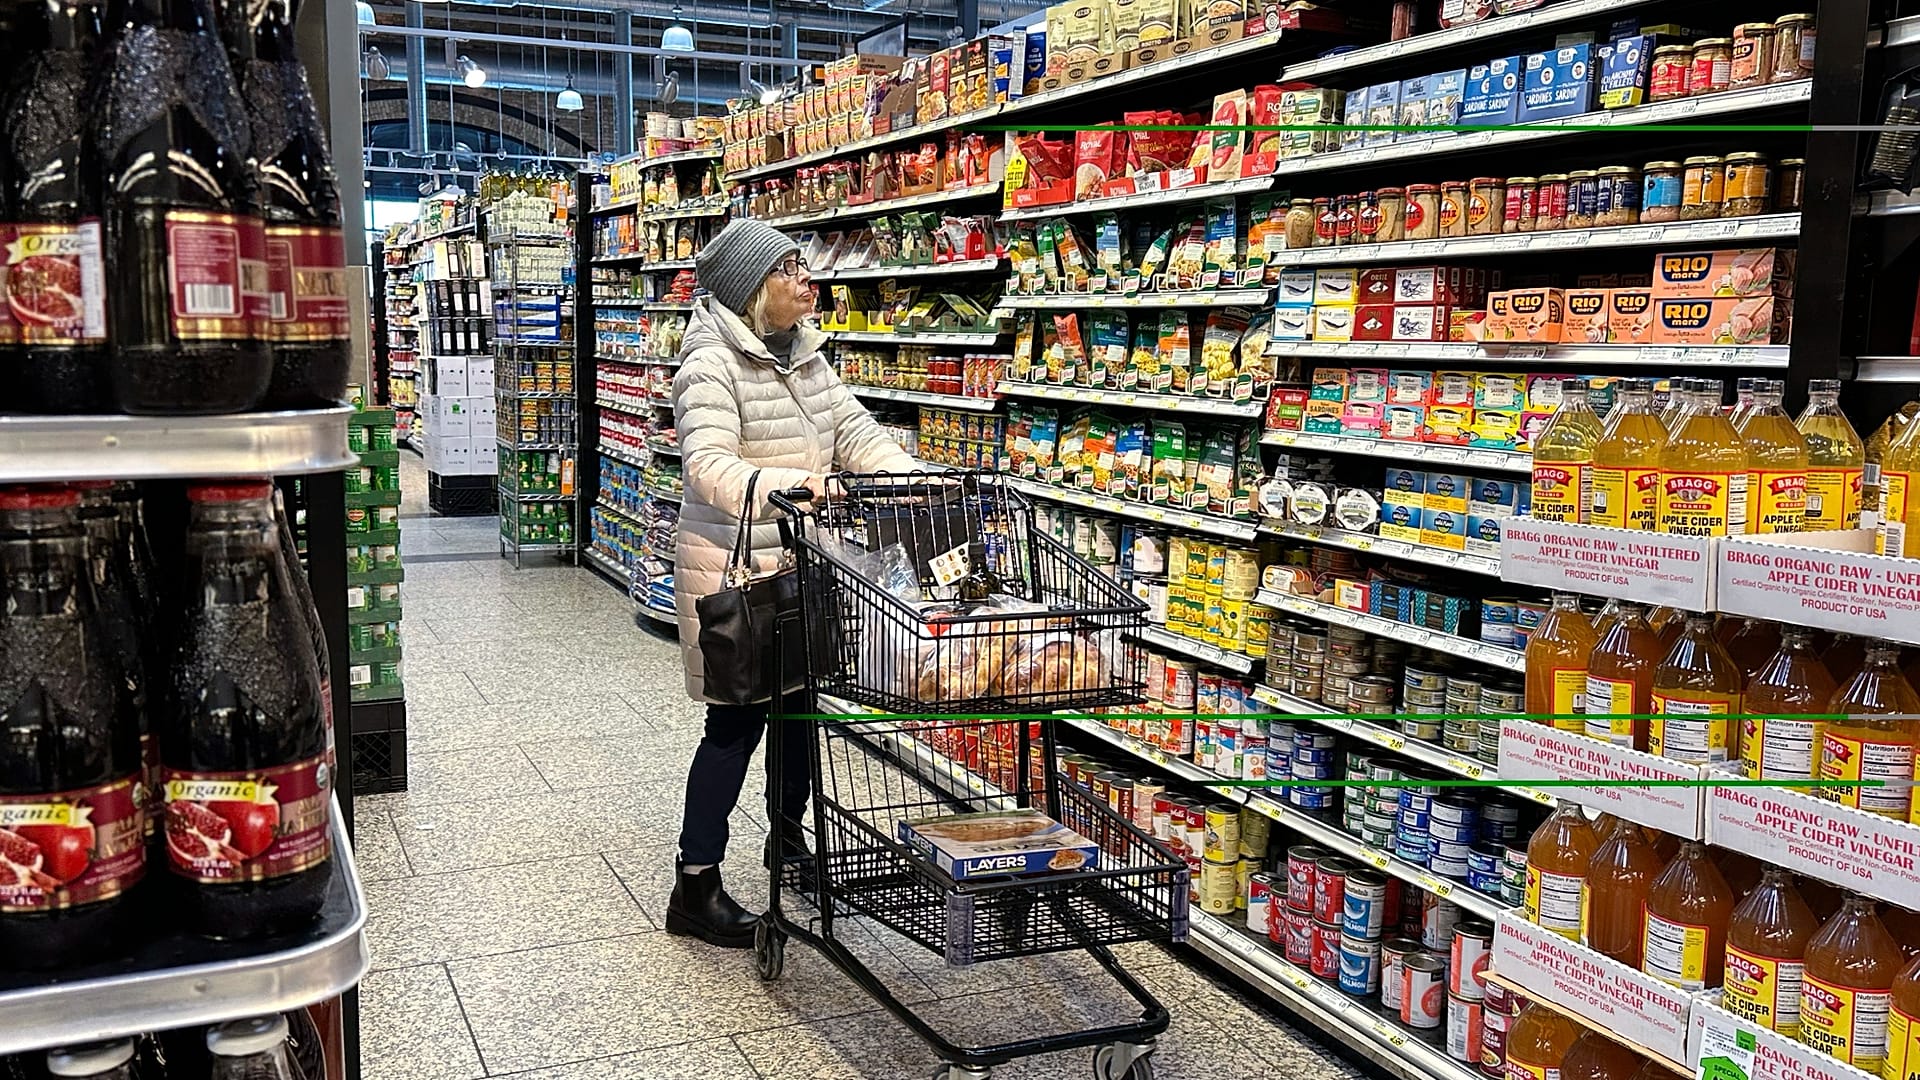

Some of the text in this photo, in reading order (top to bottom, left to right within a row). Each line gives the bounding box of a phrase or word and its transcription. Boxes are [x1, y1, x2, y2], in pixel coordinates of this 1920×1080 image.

[1610, 77, 1634, 88] FILLETS
[1463, 100, 1487, 113] SARDINE
[1080, 141, 1101, 150] ROYAL
[1251, 163, 1270, 172] ROYAL
[1664, 256, 1708, 272] RIO
[1671, 271, 1701, 280] mare
[1515, 297, 1541, 306] RIO
[1572, 297, 1600, 307] RIO
[1617, 297, 1647, 307] RIO
[1665, 304, 1708, 319] RIO
[1671, 319, 1699, 327] mare
[1315, 373, 1343, 381] SARDINES
[1309, 404, 1340, 413] SARDINES
[1670, 478, 1713, 490] BRAGG
[1547, 504, 1575, 514] CIDER
[1630, 511, 1656, 520] APPL
[1662, 515, 1722, 526] APPLE CIDER
[1763, 515, 1793, 524] APPLE
[1668, 526, 1712, 537] VINEGAR
[1507, 529, 1700, 562] BRAGG ORGANIC RAW UNFILTERED
[1538, 546, 1659, 571] APPLE CIDER VINEGAR
[1727, 550, 1873, 580] BRAGG ORGANIC RAW
[1511, 553, 1530, 562] Certified
[1531, 556, 1549, 566] Organic
[1556, 559, 1576, 569] Organic
[1649, 571, 1669, 582] Project
[1669, 574, 1694, 584] Certified
[1565, 569, 1629, 586] PRODUCT OF USA
[1767, 570, 1809, 586] APPLE
[1814, 576, 1858, 594] CIDER
[1169, 587, 1185, 596] CEN
[1731, 578, 1756, 589] Certified
[1757, 581, 1781, 593] Organic
[1782, 585, 1790, 595] by
[1791, 586, 1816, 597] Organic
[1817, 589, 1848, 602] Certifiers,
[1850, 594, 1876, 606] Kosher,
[1878, 599, 1912, 611] Non-Gmo
[1801, 598, 1887, 620] PRODUCT OF USA
[1666, 702, 1710, 711] Nutrition Facts
[1666, 721, 1687, 729] Calories
[1766, 719, 1793, 728] Nutrition
[1765, 740, 1789, 748] Calories
[1864, 744, 1897, 752] Nutrition
[1503, 726, 1691, 789] BRAGG ORGANIC RAW UNFILTERED
[1506, 751, 1525, 762] Certified
[1526, 756, 1544, 768] Organic
[1534, 748, 1566, 766] APPLE
[1569, 758, 1600, 777] CIDER
[1863, 766, 1890, 774] Calories
[171, 781, 253, 799] Organic
[1594, 786, 1622, 801] OF USA
[2, 803, 68, 823] ganic
[1714, 786, 1861, 839] BRAGG ORGANIC RAW
[1405, 828, 1428, 838] StarKist
[908, 830, 933, 853] LAYERS
[1718, 813, 1899, 876] Certified Organic by Organic Certifiers, Kosher, Non-Gmo
[1755, 812, 1914, 871] APPLE CIDER VINEGAR
[967, 855, 1027, 872] LAYERS
[1288, 858, 1314, 873] MING'S
[1788, 845, 1873, 880] PRODUCT OF USA
[1500, 923, 1533, 945] BRAGG
[1582, 959, 1606, 979] RAW
[1615, 976, 1682, 1015] UNFILTERED
[1726, 953, 1760, 975] BRAGG
[1530, 950, 1561, 974] APPLE
[1564, 965, 1595, 988] CIDER
[1598, 980, 1644, 1011] VINEGAR
[1554, 979, 1588, 1003] PRODUCT
[1589, 995, 1600, 1007] OF
[1600, 1002, 1615, 1016] USA
[1802, 982, 1836, 1005] BRAGG
[1856, 993, 1885, 1001] Nutrition
[1738, 998, 1769, 1016] CIDER
[1653, 1016, 1676, 1034] Certified
[1813, 1029, 1847, 1048] CIDER
[1755, 1041, 1802, 1072] RGANIC
[1713, 1064, 1740, 1079] SPECIAL
